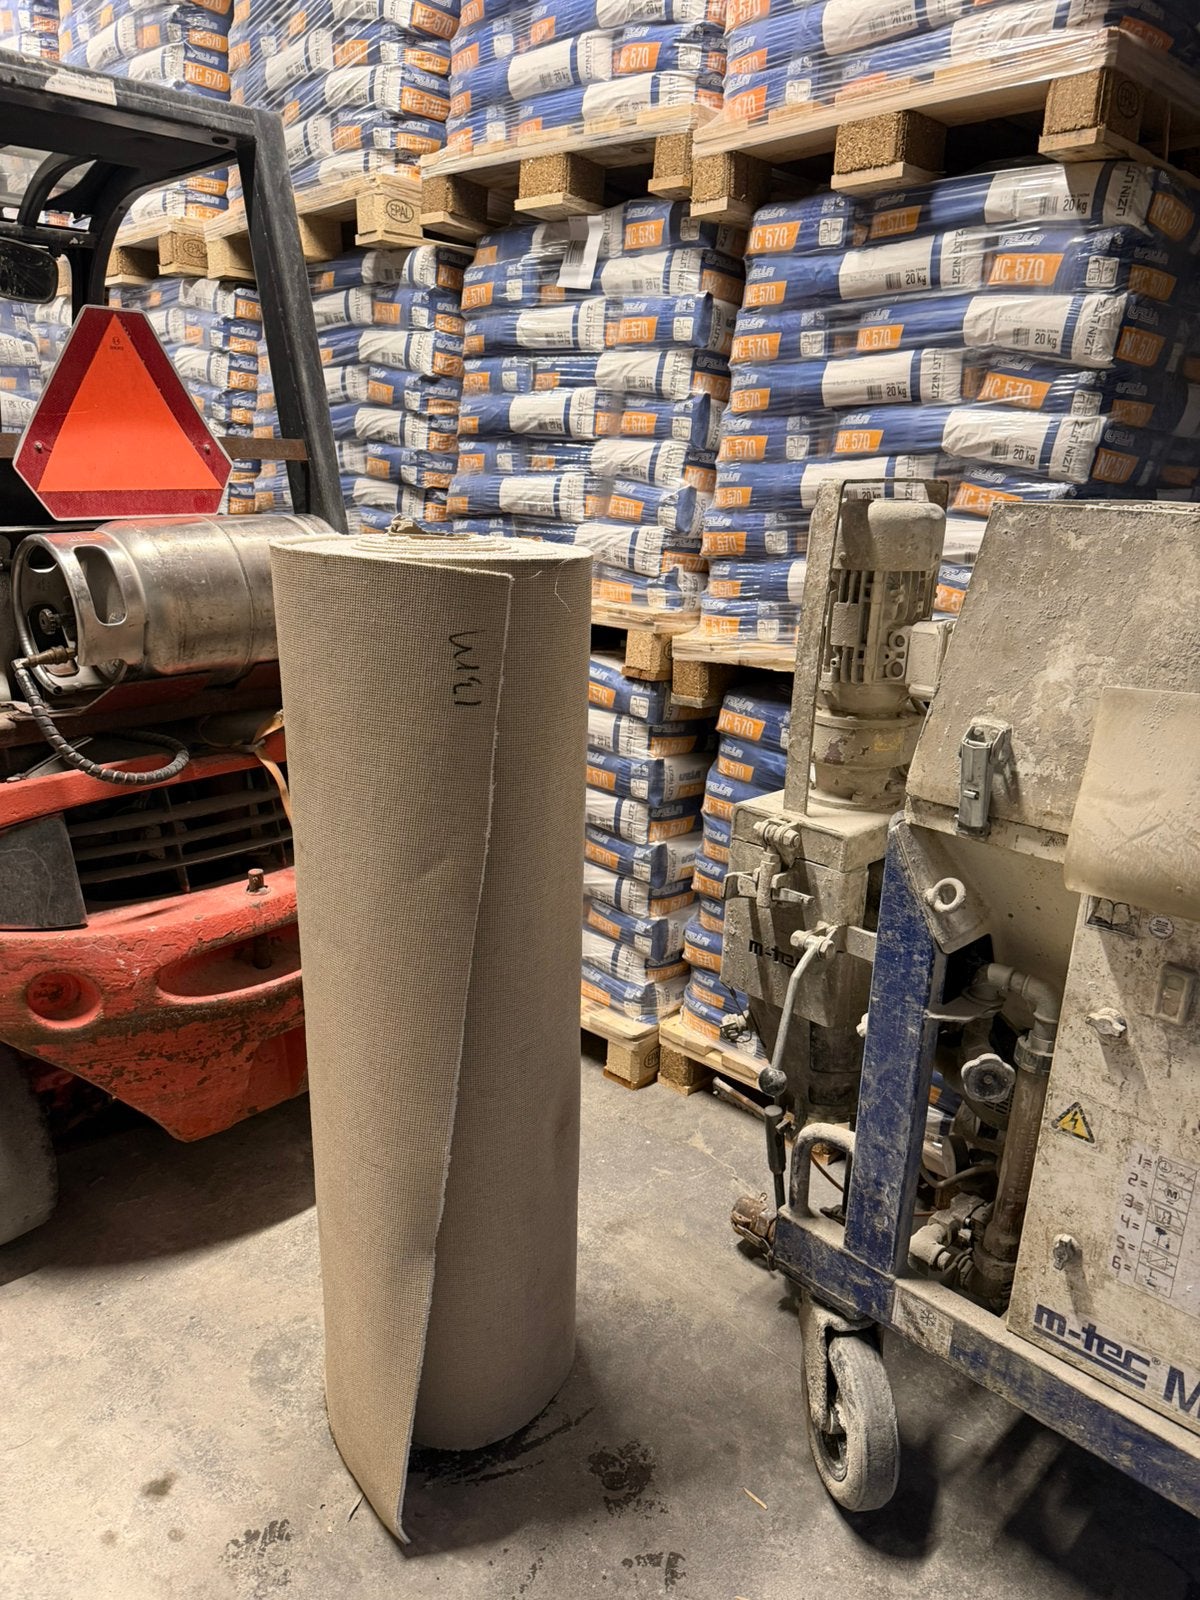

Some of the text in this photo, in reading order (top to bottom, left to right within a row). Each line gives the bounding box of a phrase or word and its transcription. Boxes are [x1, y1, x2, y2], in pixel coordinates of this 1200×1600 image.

[433, 15, 453, 36] 570
[207, 35, 221, 45] 570
[630, 48, 649, 68] 570
[189, 64, 223, 88] NC 570
[389, 204, 410, 220] EPAL
[1063, 198, 1087, 214] 20 kg
[1116, 192, 1129, 217] UZIN
[1154, 200, 1168, 221] NC
[640, 225, 655, 243] 570
[764, 224, 787, 248] 570
[906, 271, 927, 285] 20 kg
[953, 257, 961, 284] UZIN
[991, 259, 1045, 282] NC 570
[759, 285, 775, 302] 570
[859, 330, 890, 346] NC 570
[1035, 332, 1057, 348] 20 kg
[1084, 327, 1096, 356] UZIN
[750, 339, 770, 357] 570
[887, 384, 907, 398] 20 kg
[932, 370, 940, 399] UZIN
[981, 376, 1031, 403] NC 570
[746, 391, 760, 405] 570
[734, 440, 756, 457] 570
[838, 433, 870, 448] NC 570
[1014, 448, 1035, 465] 20 kg
[1061, 445, 1075, 473] UZIN
[728, 491, 743, 504] 570
[954, 486, 974, 507] NC
[717, 534, 736, 553] 570
[593, 688, 608, 701] 570
[719, 713, 753, 736] NC 570
[730, 760, 744, 777] 570
[593, 771, 608, 786] 570
[697, 951, 715, 968] 570
[1167, 1188, 1177, 1199] M
[1034, 1304, 1151, 1382] m-tec
